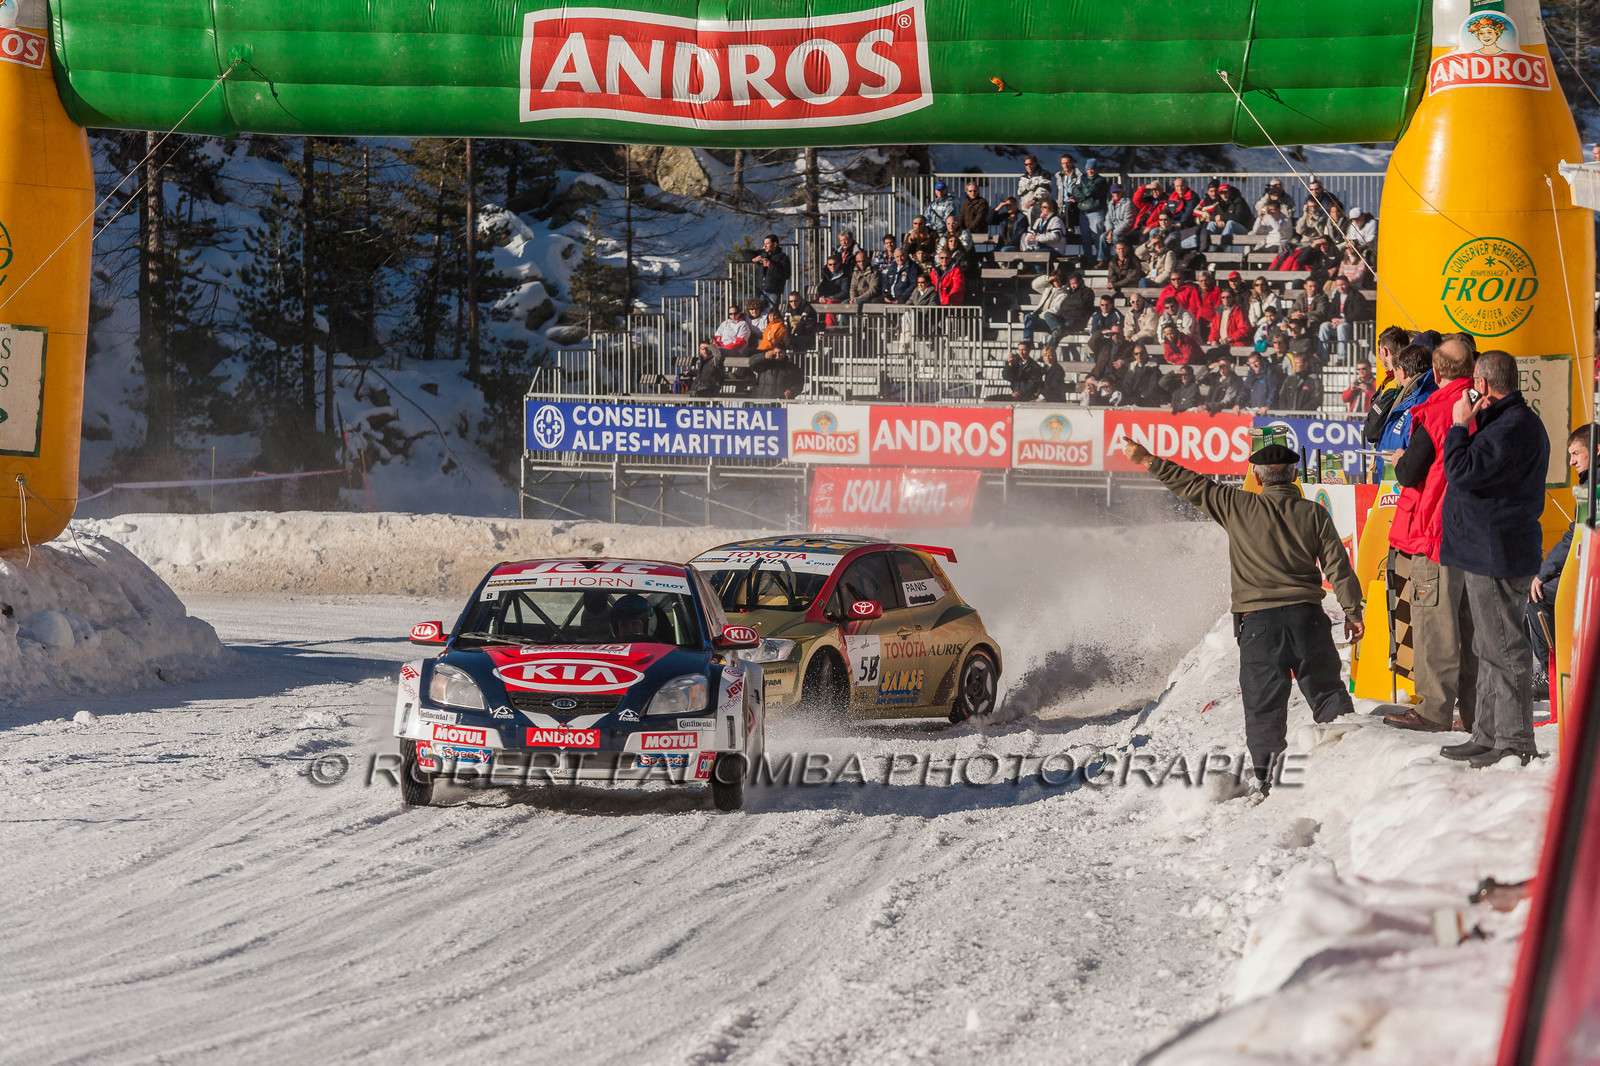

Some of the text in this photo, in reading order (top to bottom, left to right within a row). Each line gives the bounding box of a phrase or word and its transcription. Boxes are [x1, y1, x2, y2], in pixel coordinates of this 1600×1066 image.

[541, 29, 902, 108] ANDROS
[1432, 56, 1544, 86] ANDROS
[1450, 243, 1489, 273] CONSERVER
[1440, 277, 1538, 302] FROID
[1454, 306, 1464, 314] LE
[1484, 321, 1496, 330] EST
[1498, 306, 1524, 328] NATUREL
[1476, 308, 1503, 319] AGITER
[572, 405, 779, 430] CONSEIL GENERAL
[572, 430, 779, 456] ALPES-MARITIMES
[794, 434, 856, 453] ANDROS
[872, 419, 1007, 457] ANDROS
[1106, 423, 1250, 463] ANDROS
[1020, 442, 1089, 463] ANDROS
[842, 479, 947, 515] ISOLA 2000
[727, 551, 807, 560] TOYOTA
[543, 577, 634, 587] THORN
[905, 582, 927, 592] PANIS
[414, 626, 432, 635] KIA
[730, 630, 753, 639] KIA
[884, 641, 927, 659] TOYOTA
[927, 643, 963, 656] AURIS
[522, 665, 619, 683] KIA
[880, 669, 924, 693] SAMSE
[679, 720, 712, 728] Continental
[434, 726, 484, 744] MOTUL
[531, 730, 595, 745] ANDROS
[644, 734, 696, 748] MOTUL
[443, 747, 491, 762] Speedy
[640, 754, 688, 767] Speedy
